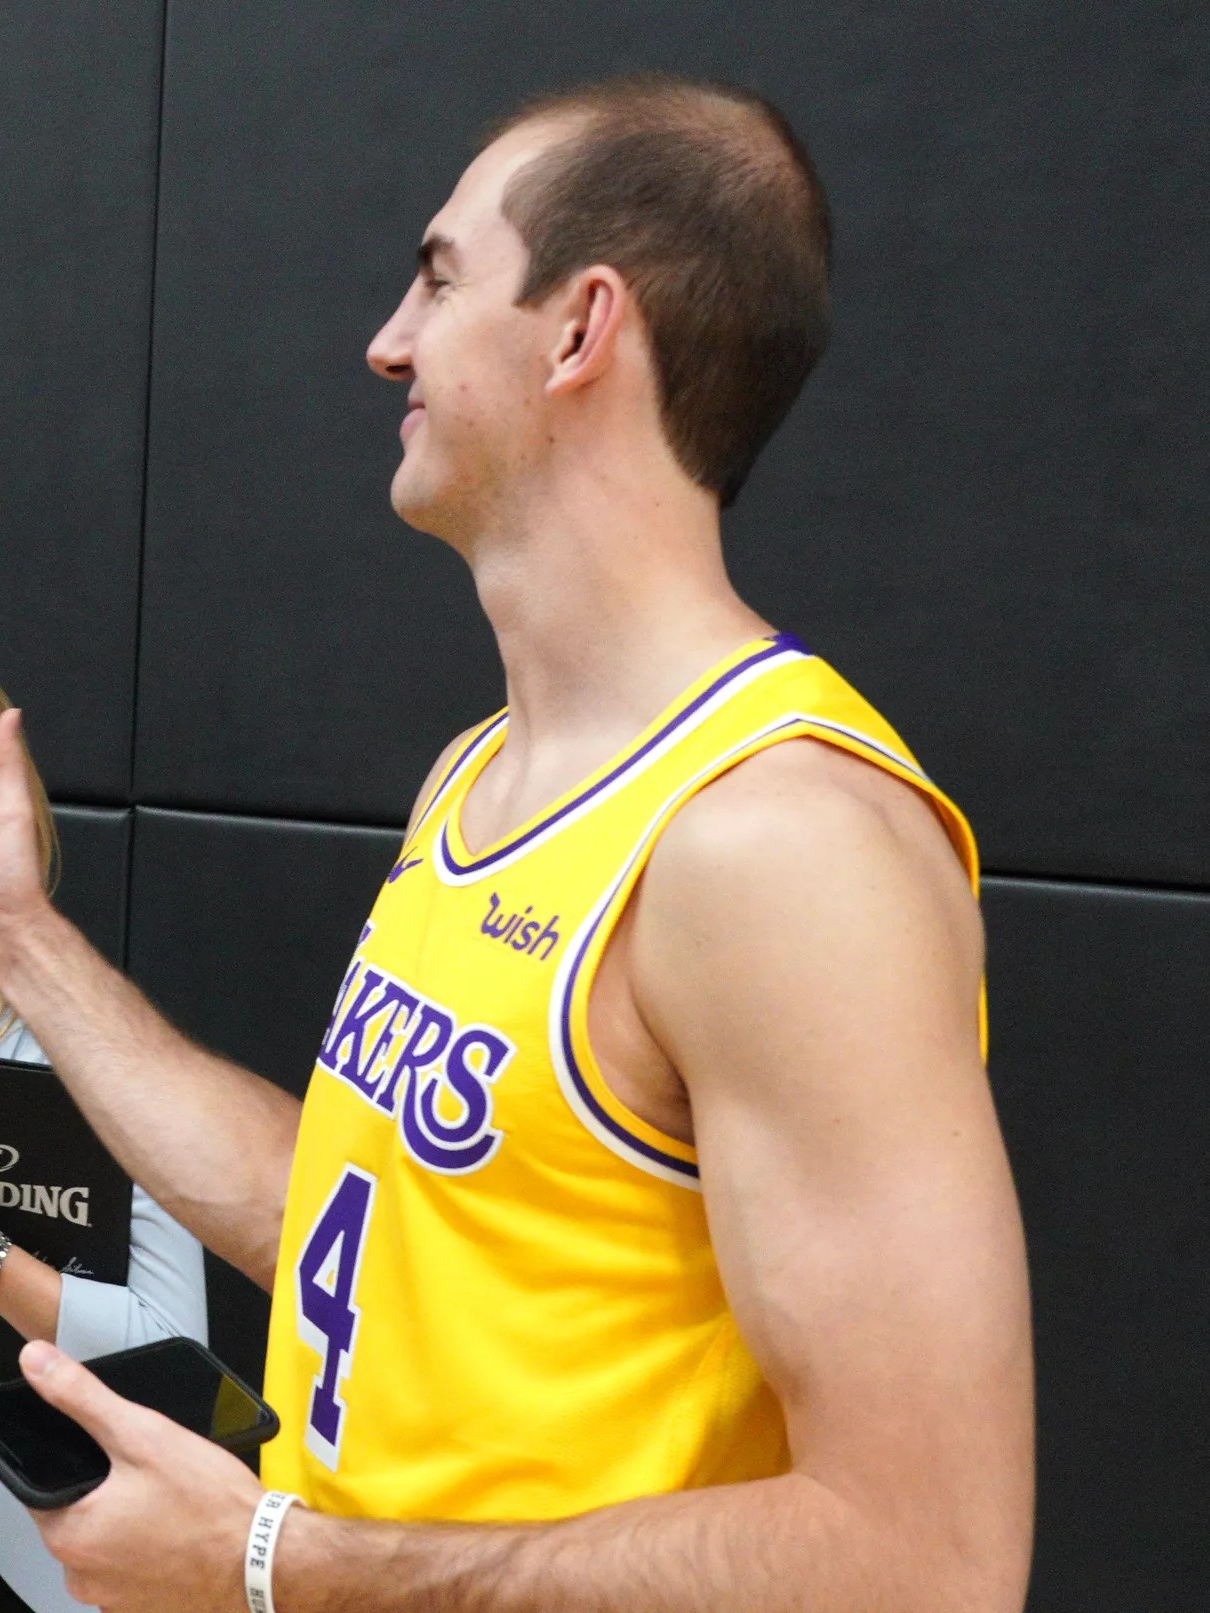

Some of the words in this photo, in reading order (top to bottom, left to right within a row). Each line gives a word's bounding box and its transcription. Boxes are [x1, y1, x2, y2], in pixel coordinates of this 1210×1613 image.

[481, 892, 559, 960] wish
[294, 1162, 377, 1473] 4
[250, 1516, 274, 1570] HYPE
